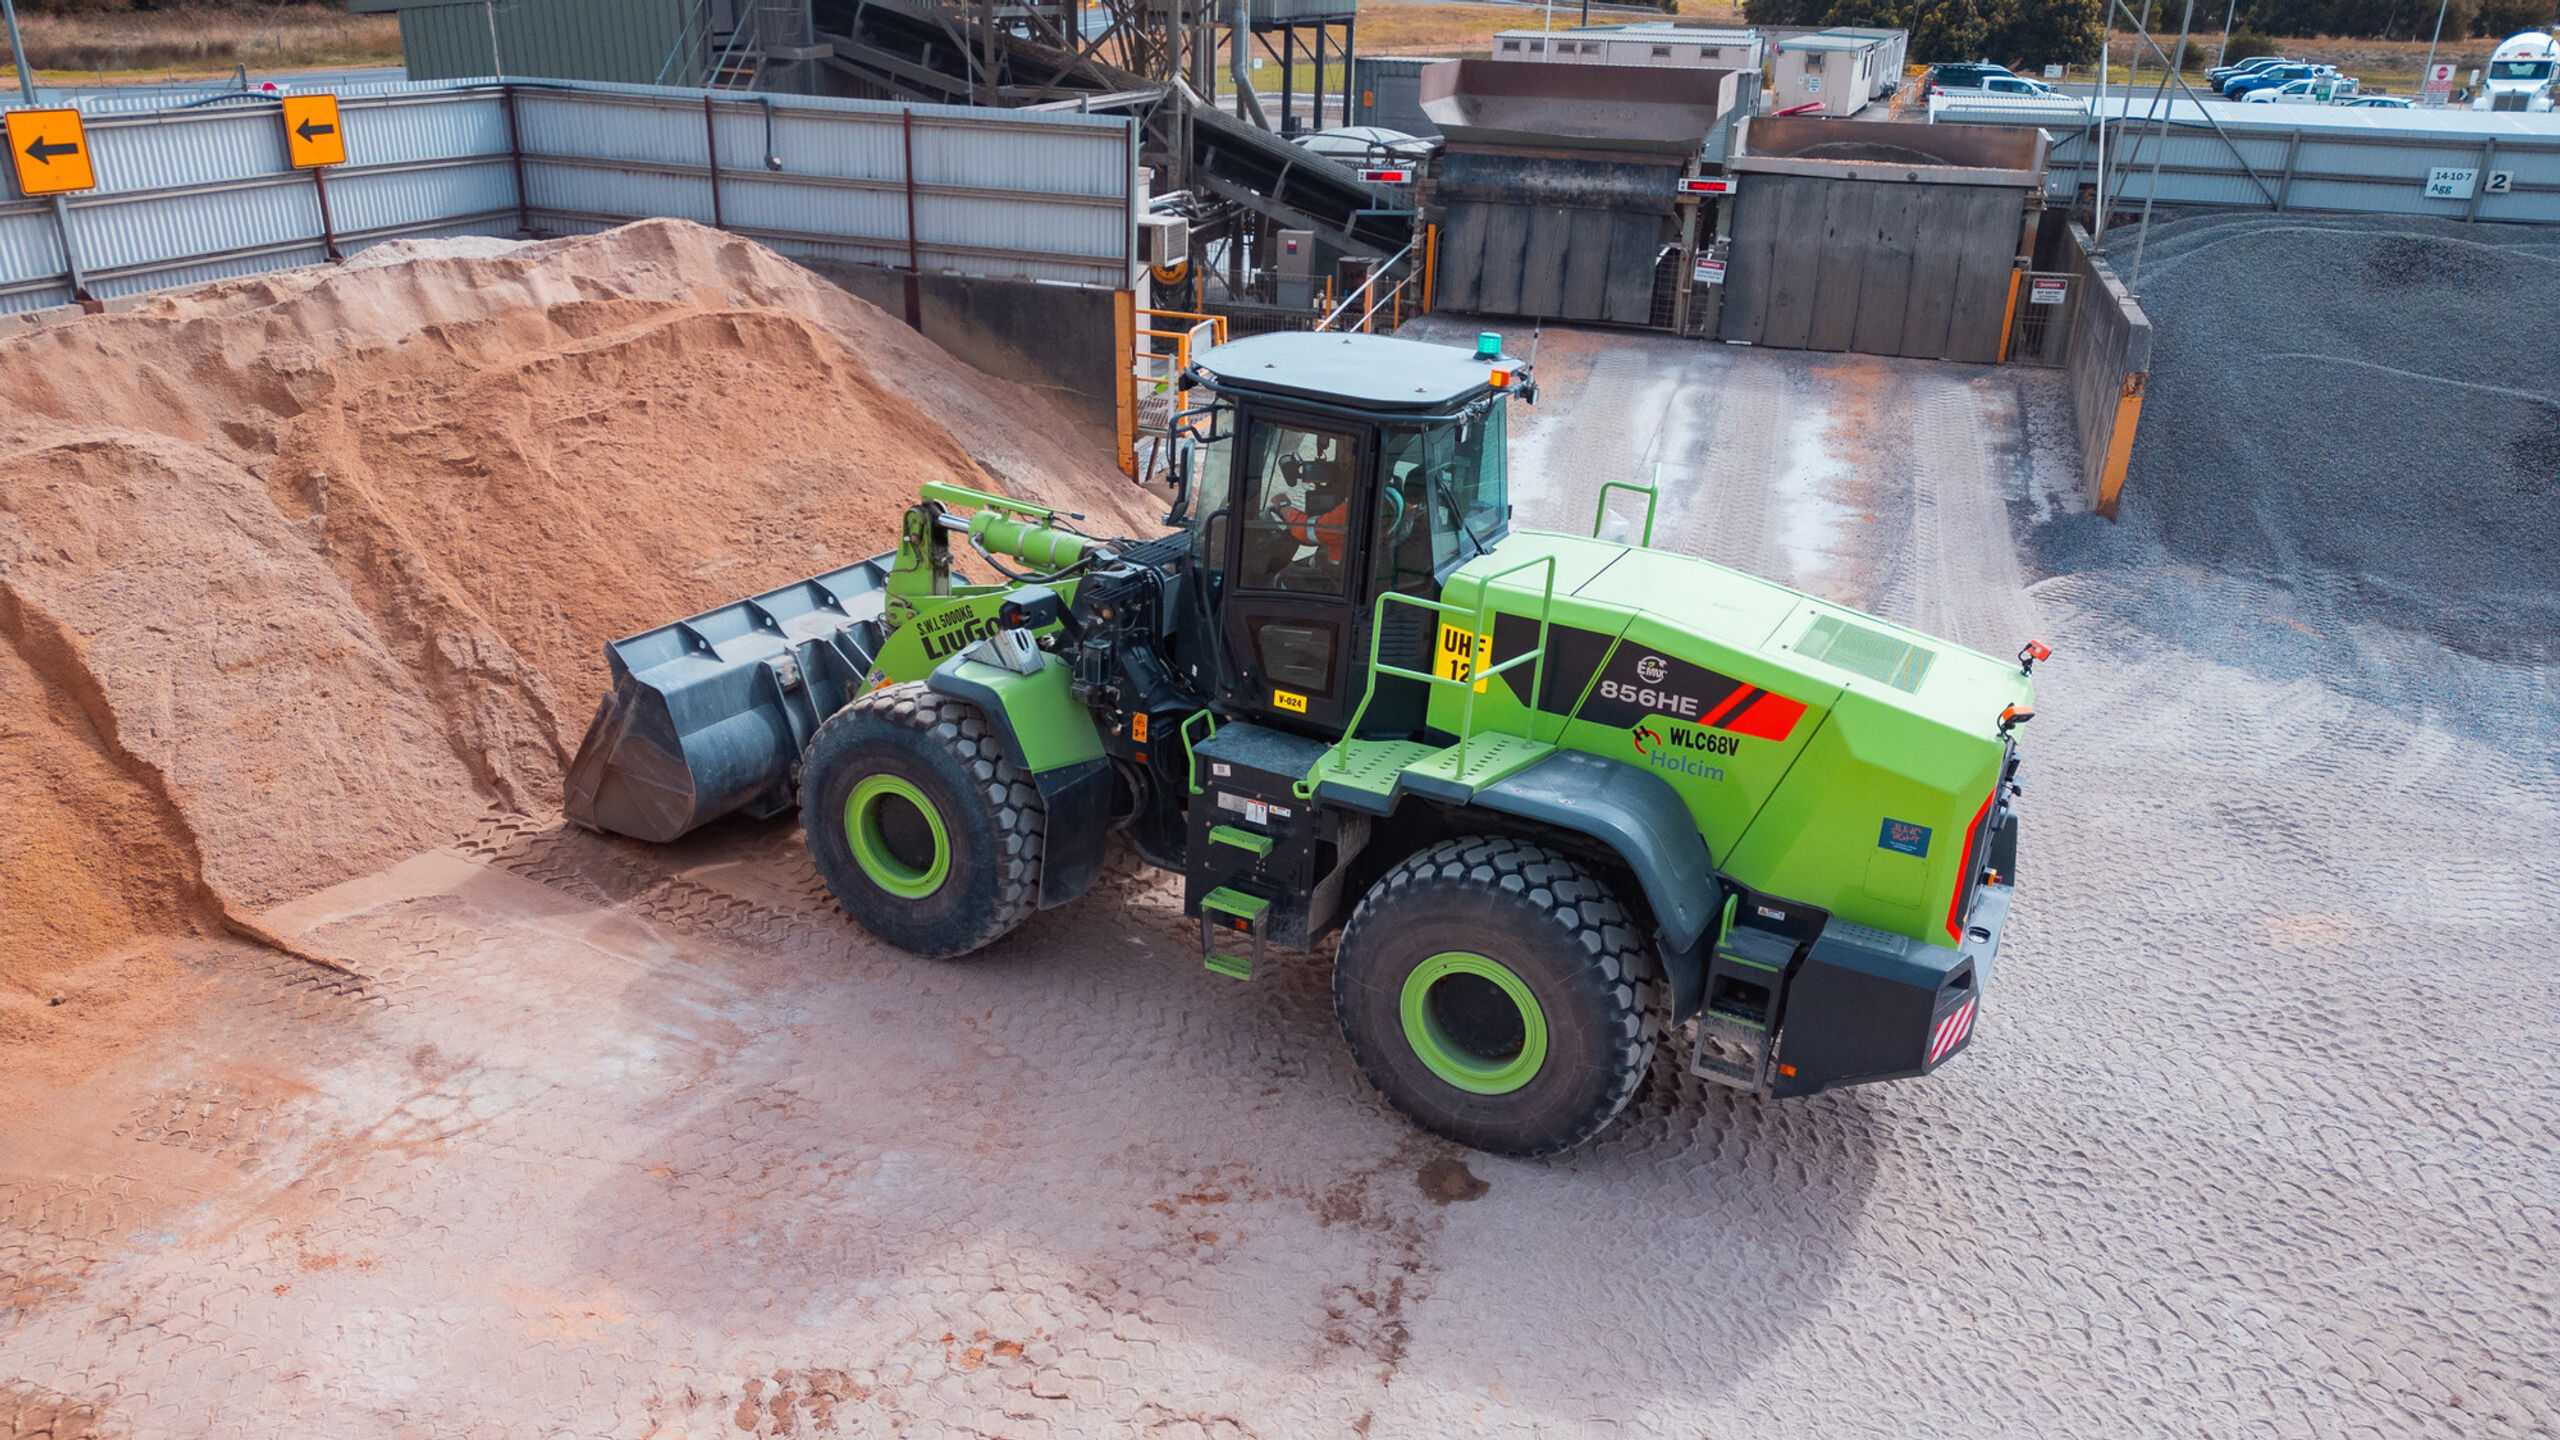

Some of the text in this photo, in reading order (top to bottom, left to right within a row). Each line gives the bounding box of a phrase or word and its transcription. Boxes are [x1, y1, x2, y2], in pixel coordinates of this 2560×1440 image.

[2431, 183, 2453, 195] Agg
[2491, 174, 2507, 189] 2
[939, 604, 974, 628] 5000KG
[1279, 695, 1302, 708] V-024
[1600, 680, 1698, 716] 856HE
[1670, 726, 1740, 757] WLC68V
[1650, 750, 1724, 782] Holcim
